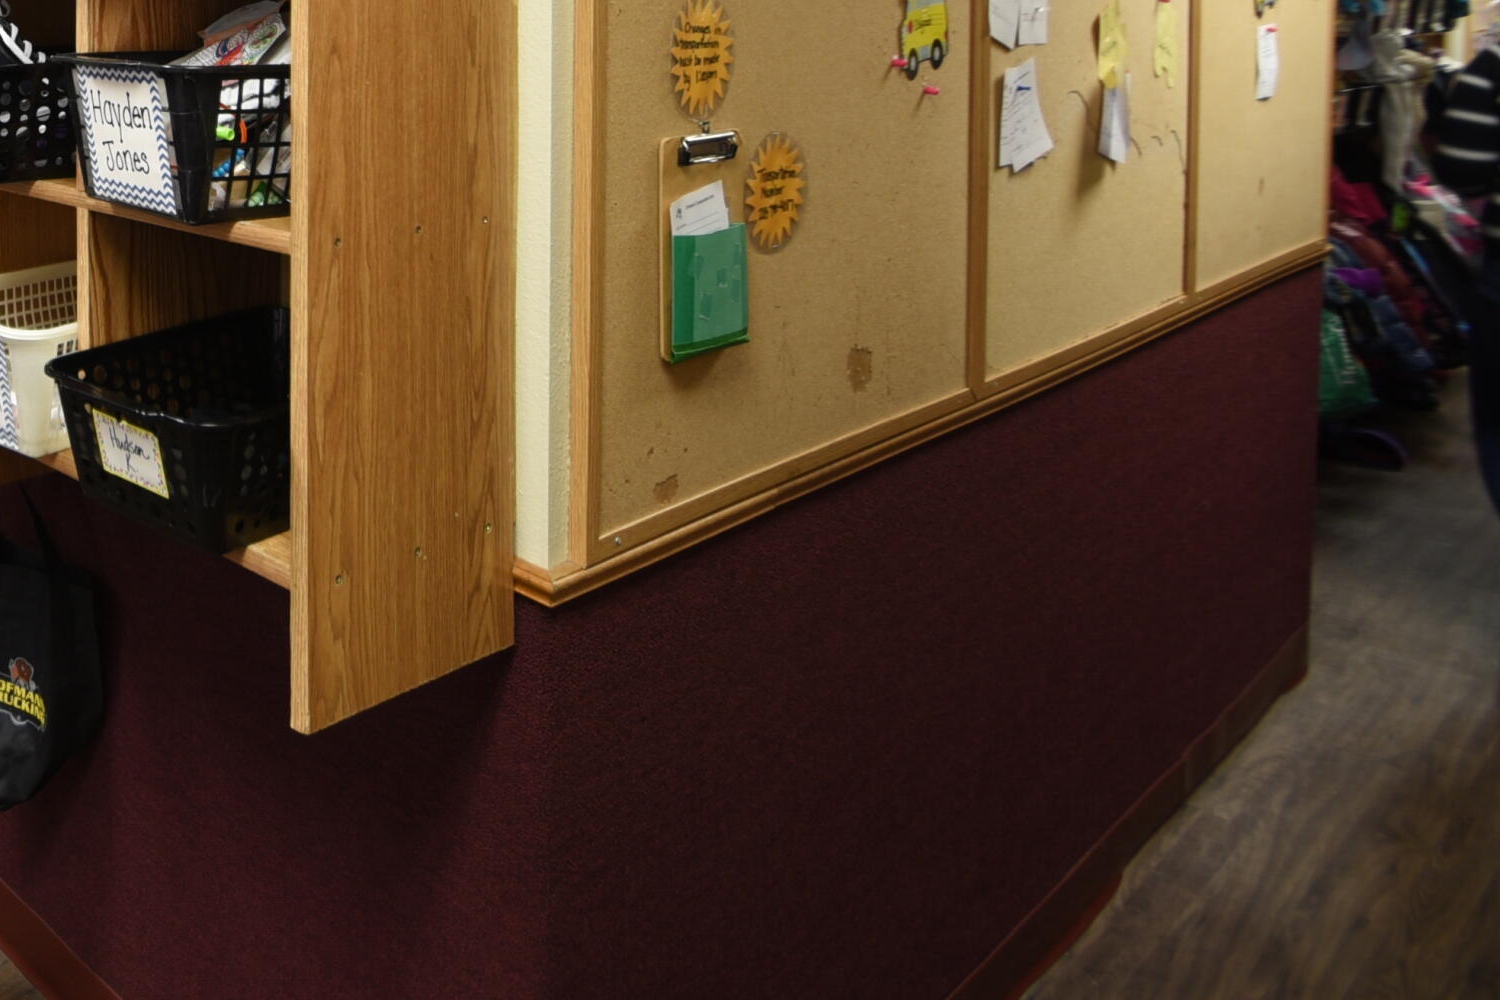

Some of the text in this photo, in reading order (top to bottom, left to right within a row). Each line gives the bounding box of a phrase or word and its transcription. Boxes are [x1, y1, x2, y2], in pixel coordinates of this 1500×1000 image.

[91, 90, 154, 143] Hayden
[102, 140, 151, 174] Jones
[109, 425, 151, 460] Hudson
